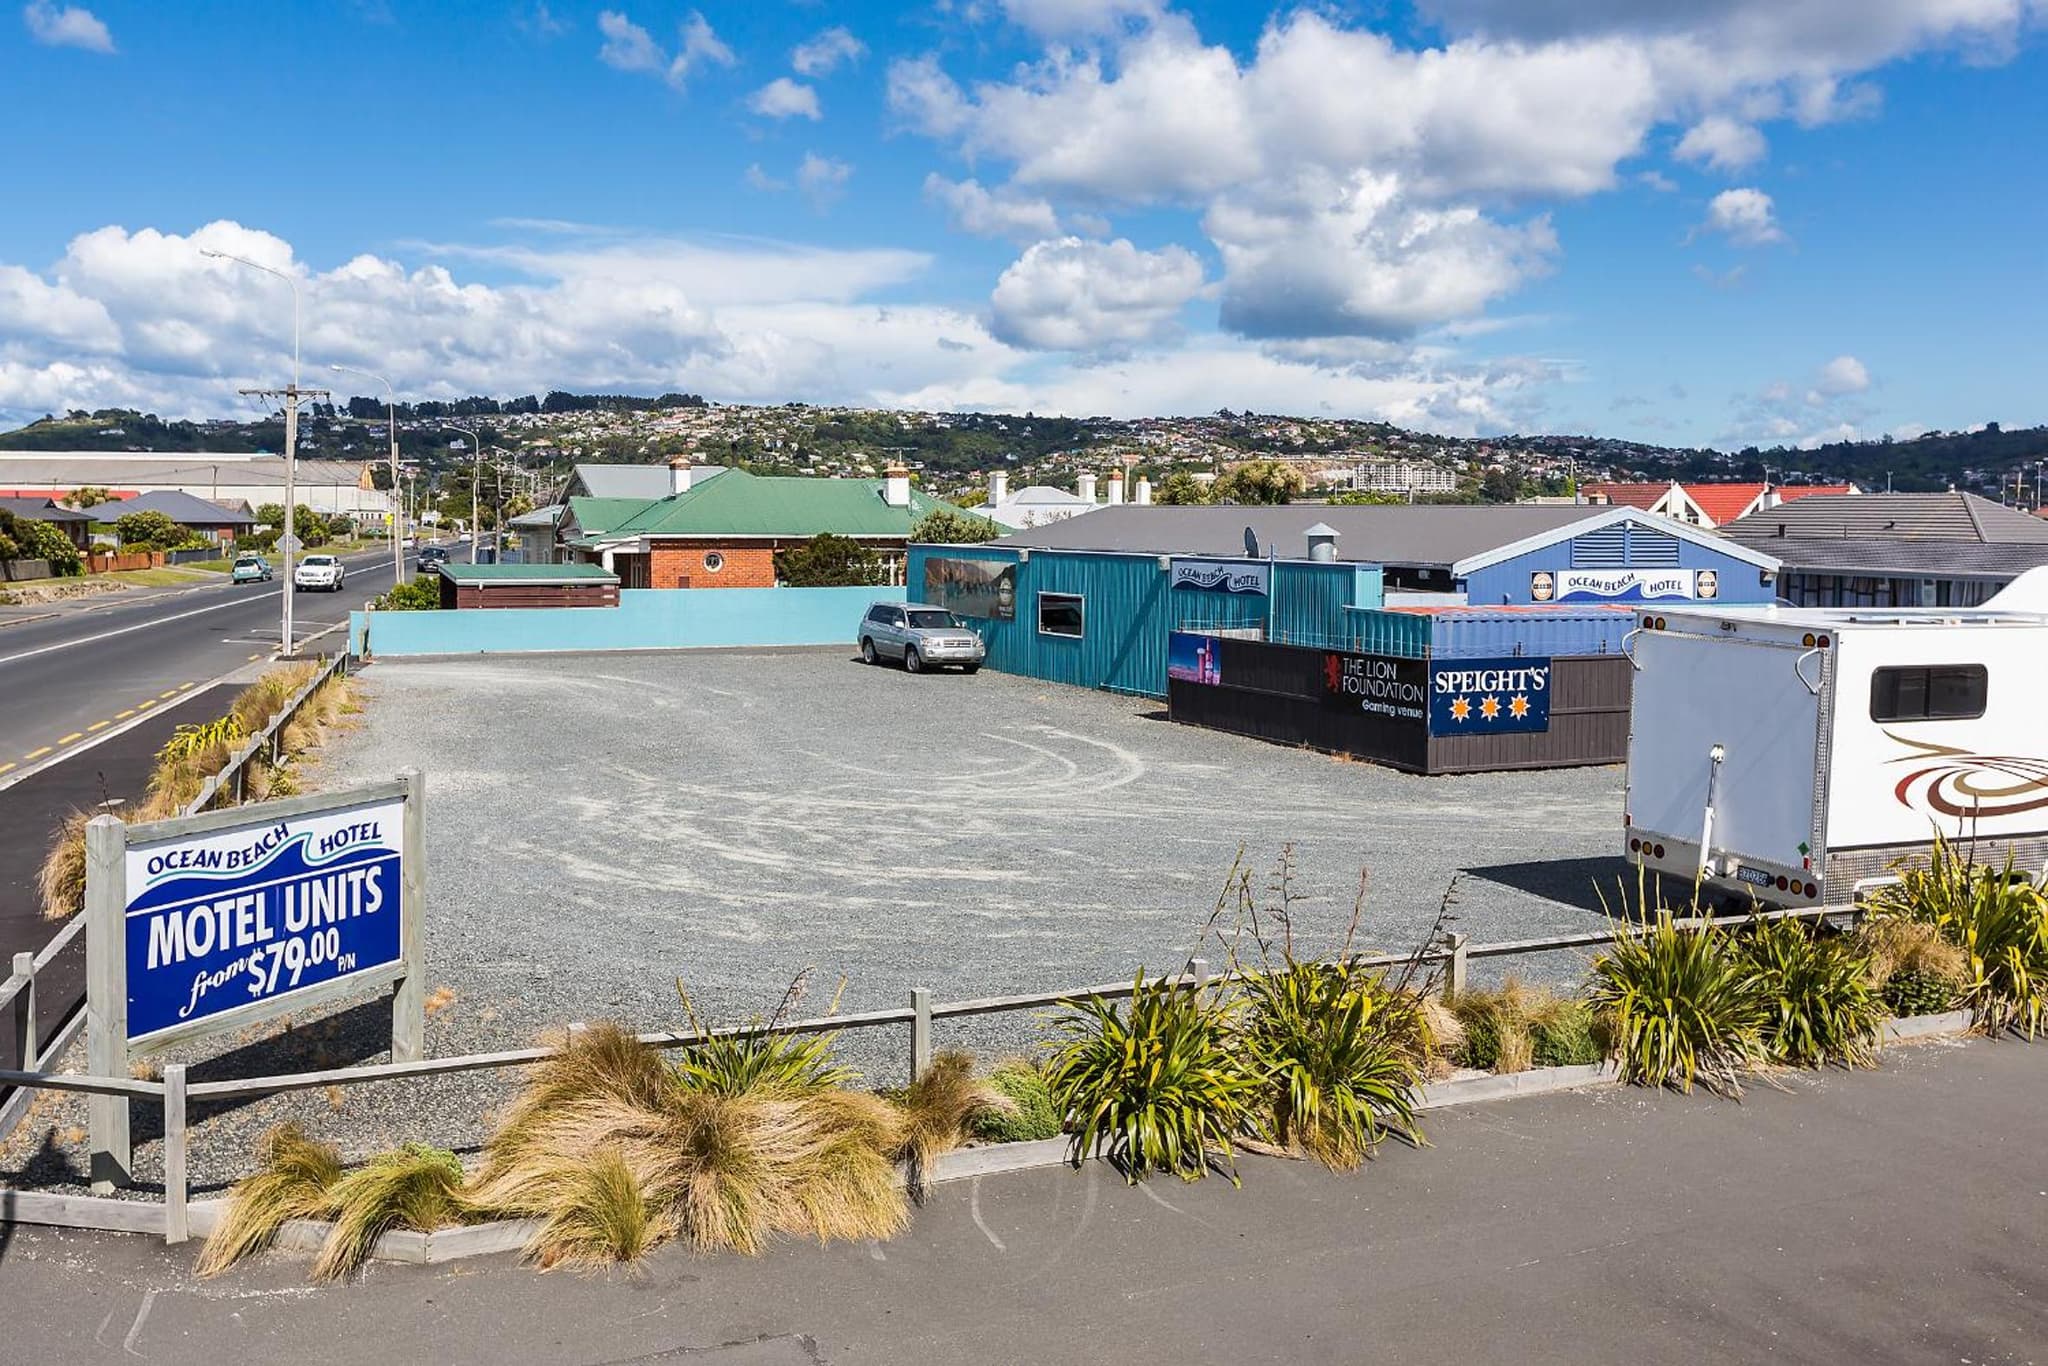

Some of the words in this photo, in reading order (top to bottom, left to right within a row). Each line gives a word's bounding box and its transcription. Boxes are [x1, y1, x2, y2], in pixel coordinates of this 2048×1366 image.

[1178, 567, 1202, 580] OCEAN
[1202, 566, 1224, 583] BEACH
[1234, 575, 1260, 587] HOTEL
[1568, 576, 1602, 589] OCEAN
[1604, 573, 1635, 591] BEACH
[1650, 580, 1683, 593] HOTEL
[1343, 657, 1363, 676] THE
[1366, 660, 1397, 680] LION
[1435, 667, 1547, 694] SPEIGHT'S
[1342, 675, 1424, 703] FOUNDATION
[1362, 699, 1396, 717] Gaming
[1397, 705, 1424, 719] venue
[147, 848, 222, 875] OCEAN
[226, 822, 290, 870] BEACH
[319, 821, 383, 855] HOTEL
[147, 891, 275, 970] MOTEL
[285, 865, 383, 933] UNITS
[179, 957, 248, 1018] from
[247, 926, 340, 998] $79.00
[337, 952, 356, 973] P/N
